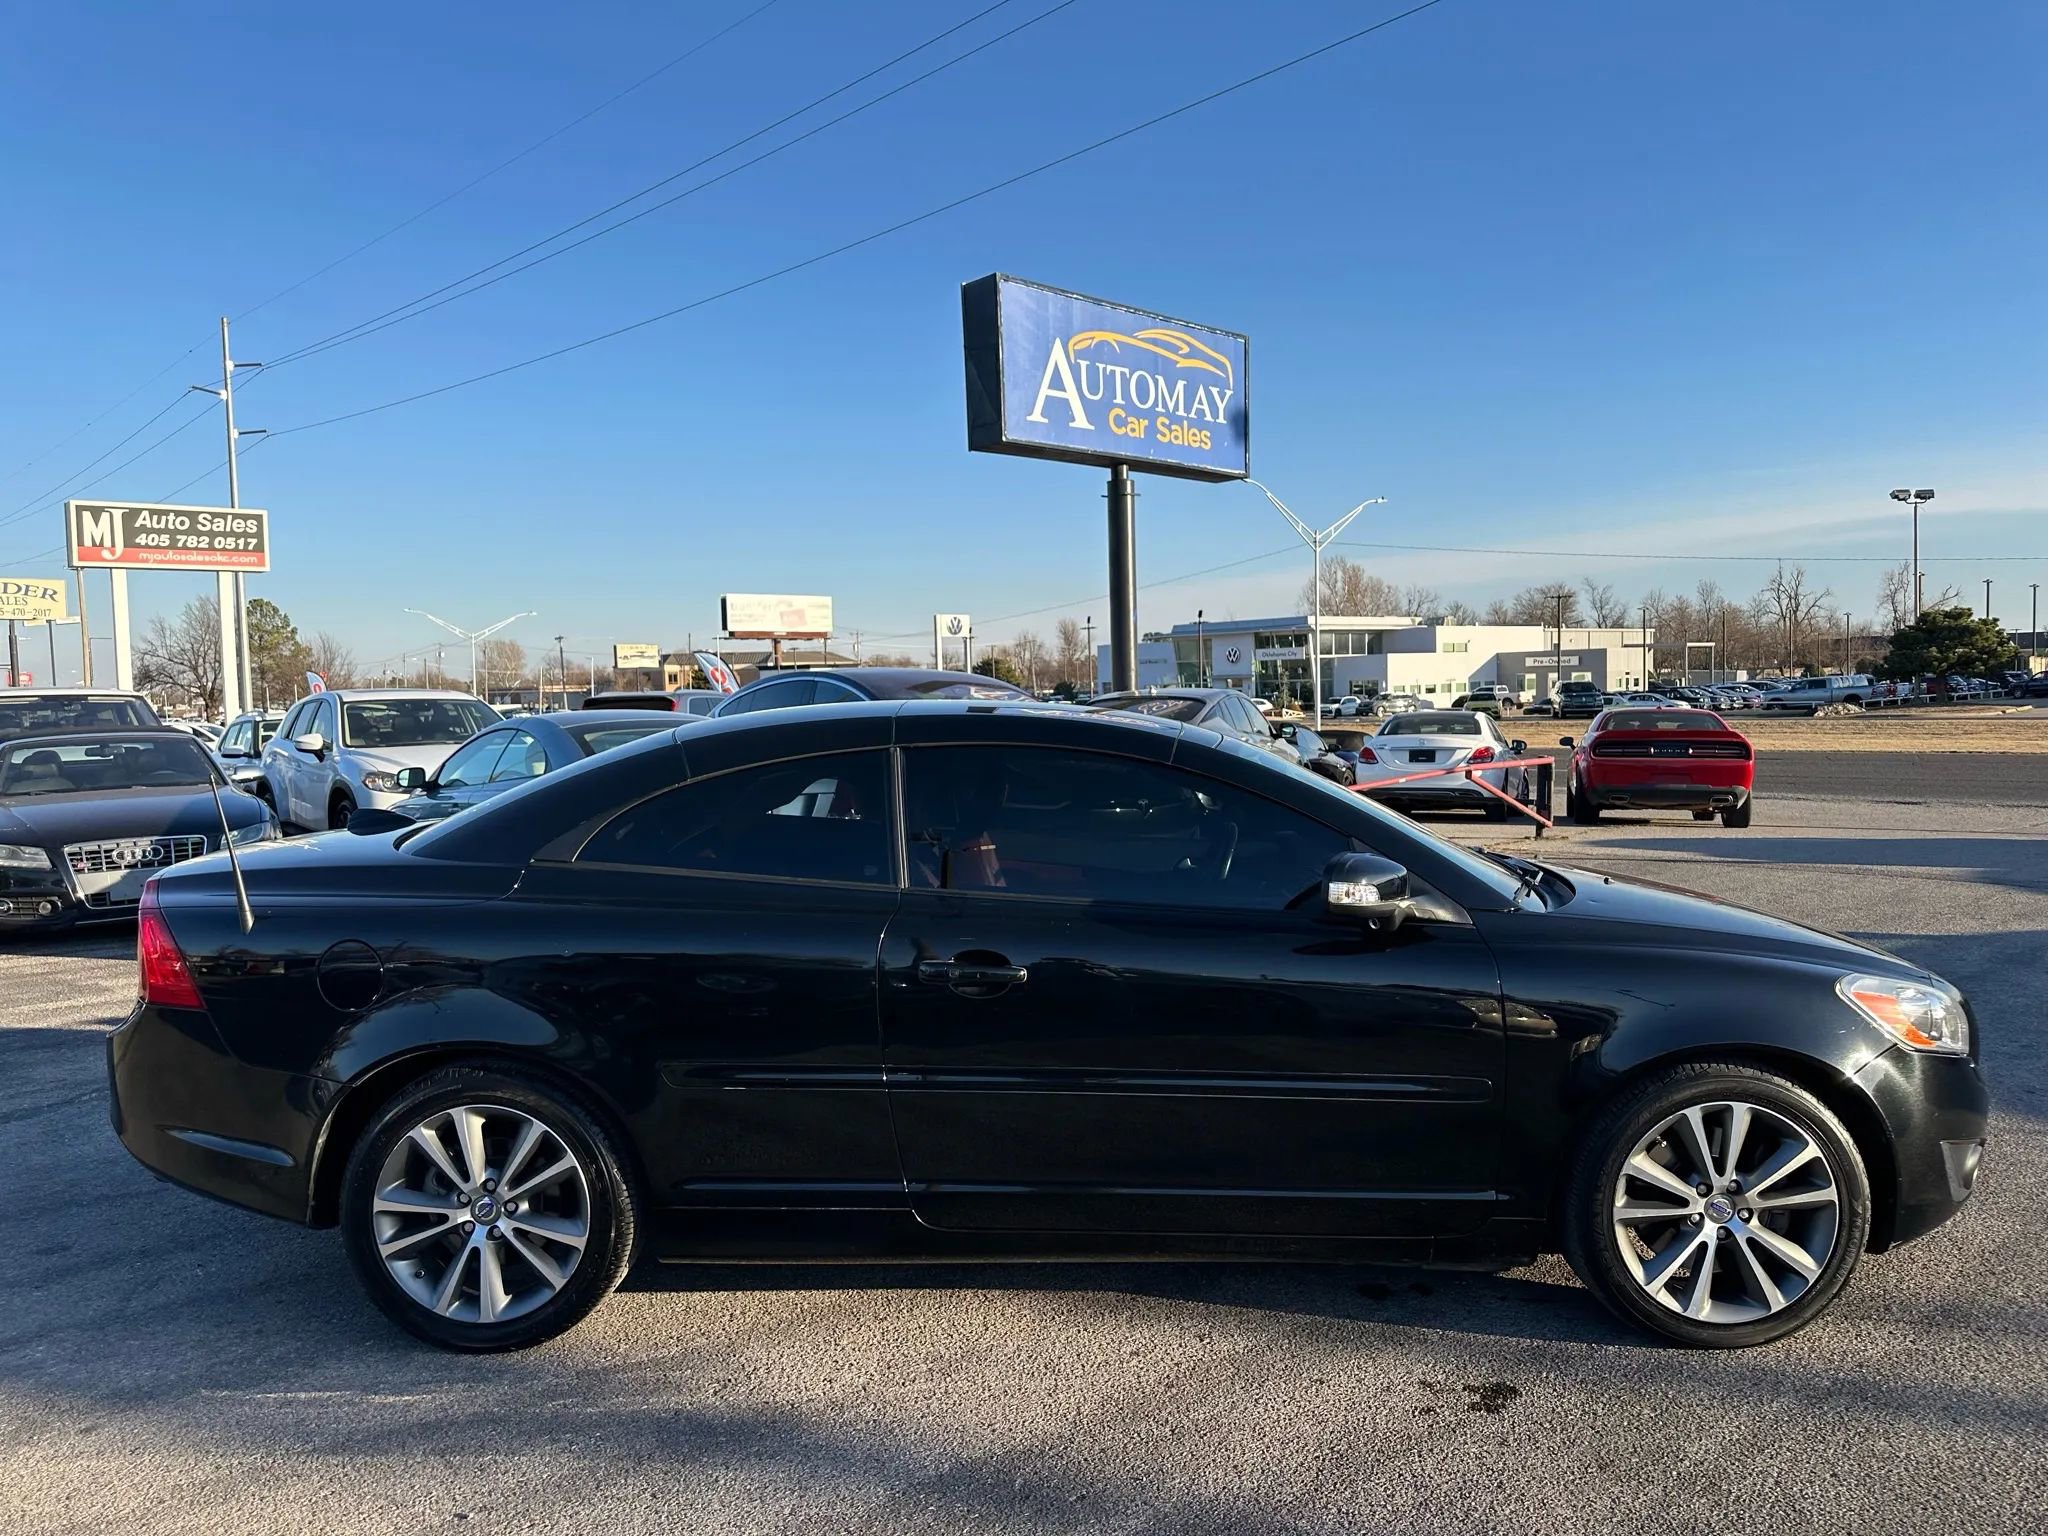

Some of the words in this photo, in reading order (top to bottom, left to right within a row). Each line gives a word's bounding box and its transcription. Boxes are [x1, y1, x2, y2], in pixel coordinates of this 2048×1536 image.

[1108, 408, 1149, 438] Car
[1156, 417, 1212, 450] Sales
[134, 510, 190, 531] Auto
[196, 513, 258, 533] Sales
[82, 508, 130, 560] MJ
[135, 533, 171, 547] 405
[176, 535, 210, 549] 782
[213, 537, 258, 551] 0517
[139, 551, 258, 564] mjautosalesokc.com
